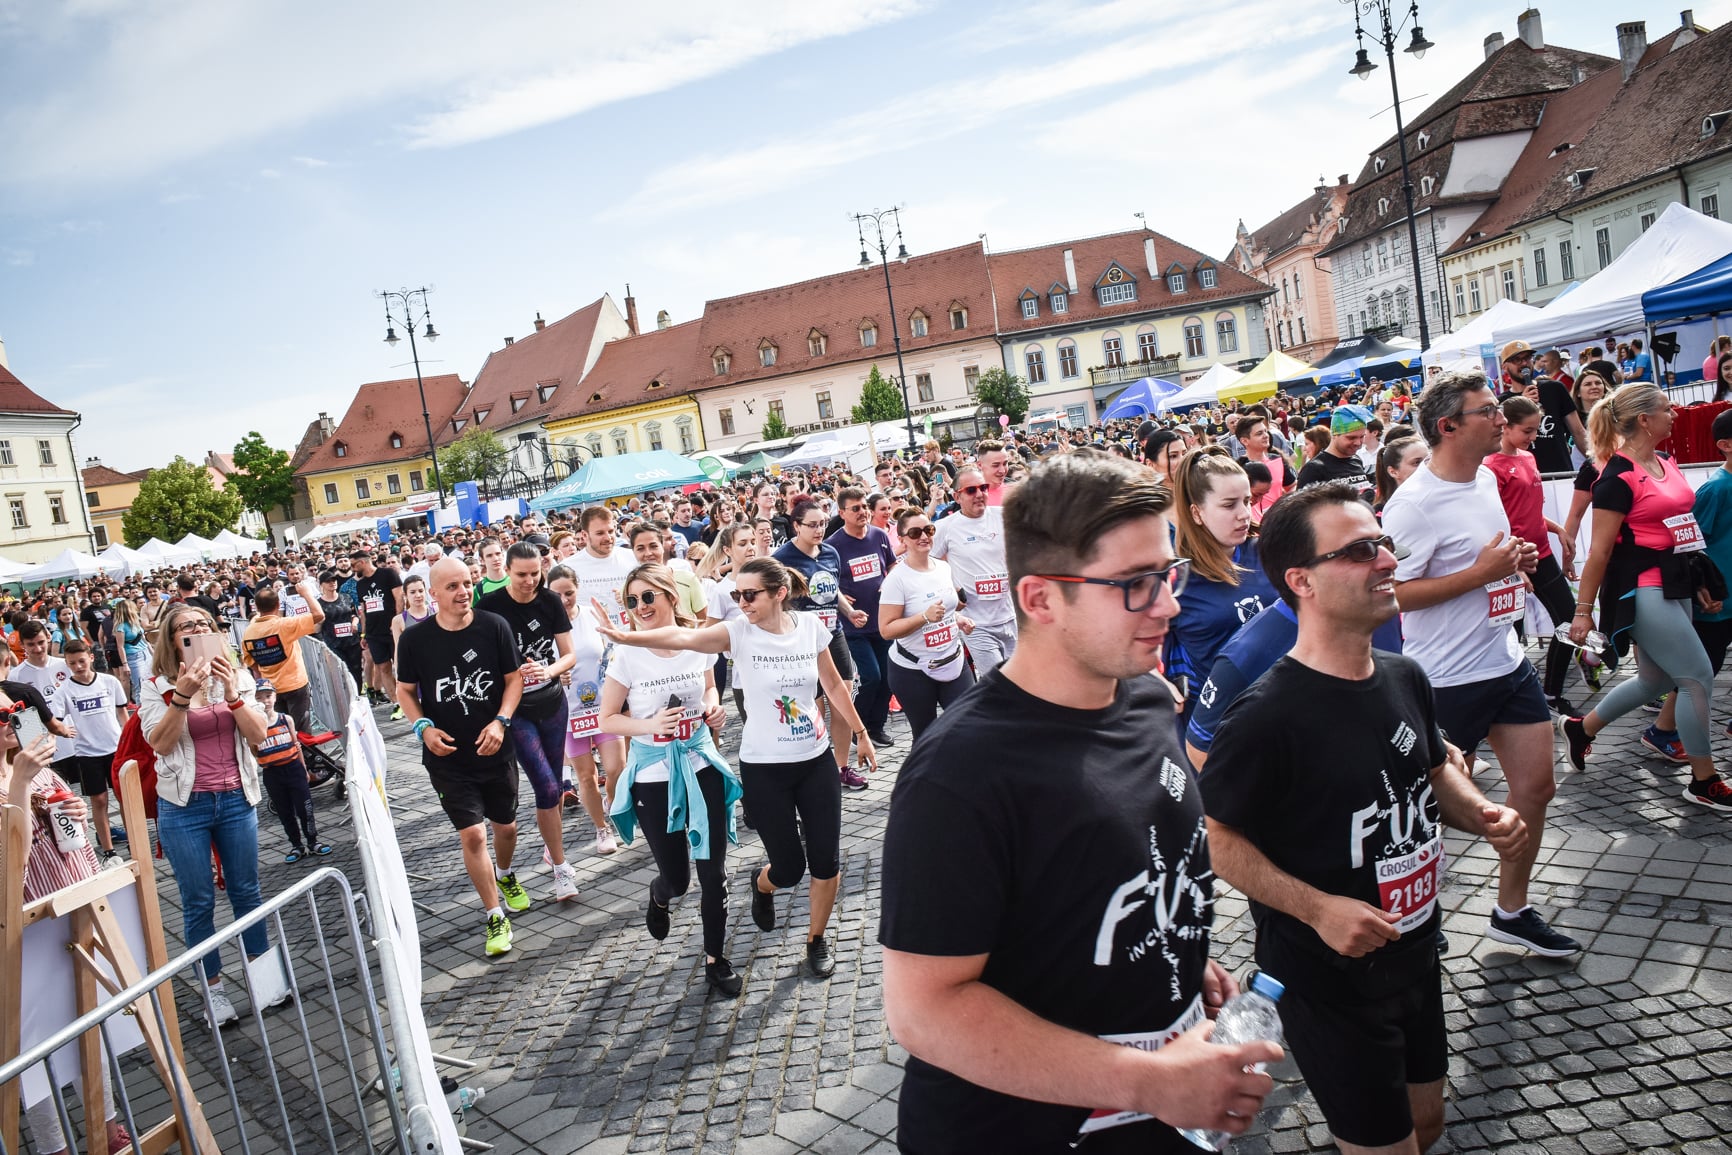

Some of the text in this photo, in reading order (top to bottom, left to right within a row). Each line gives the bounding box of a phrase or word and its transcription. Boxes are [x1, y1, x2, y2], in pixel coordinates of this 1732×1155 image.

[1674, 526, 1694, 542] 2566
[853, 563, 871, 575] 2815
[809, 582, 837, 596] 2Ship
[978, 582, 999, 594] 2923
[1491, 592, 1513, 613] 2830
[927, 631, 949, 646] 2922
[753, 661, 811, 671] CHALLEN
[436, 670, 493, 702] FUG
[642, 680, 698, 696] CHALLEN
[82, 701, 97, 709] 722
[573, 717, 596, 730] 2934
[1380, 857, 1417, 877] CROSUL
[1389, 871, 1433, 914] 2193
